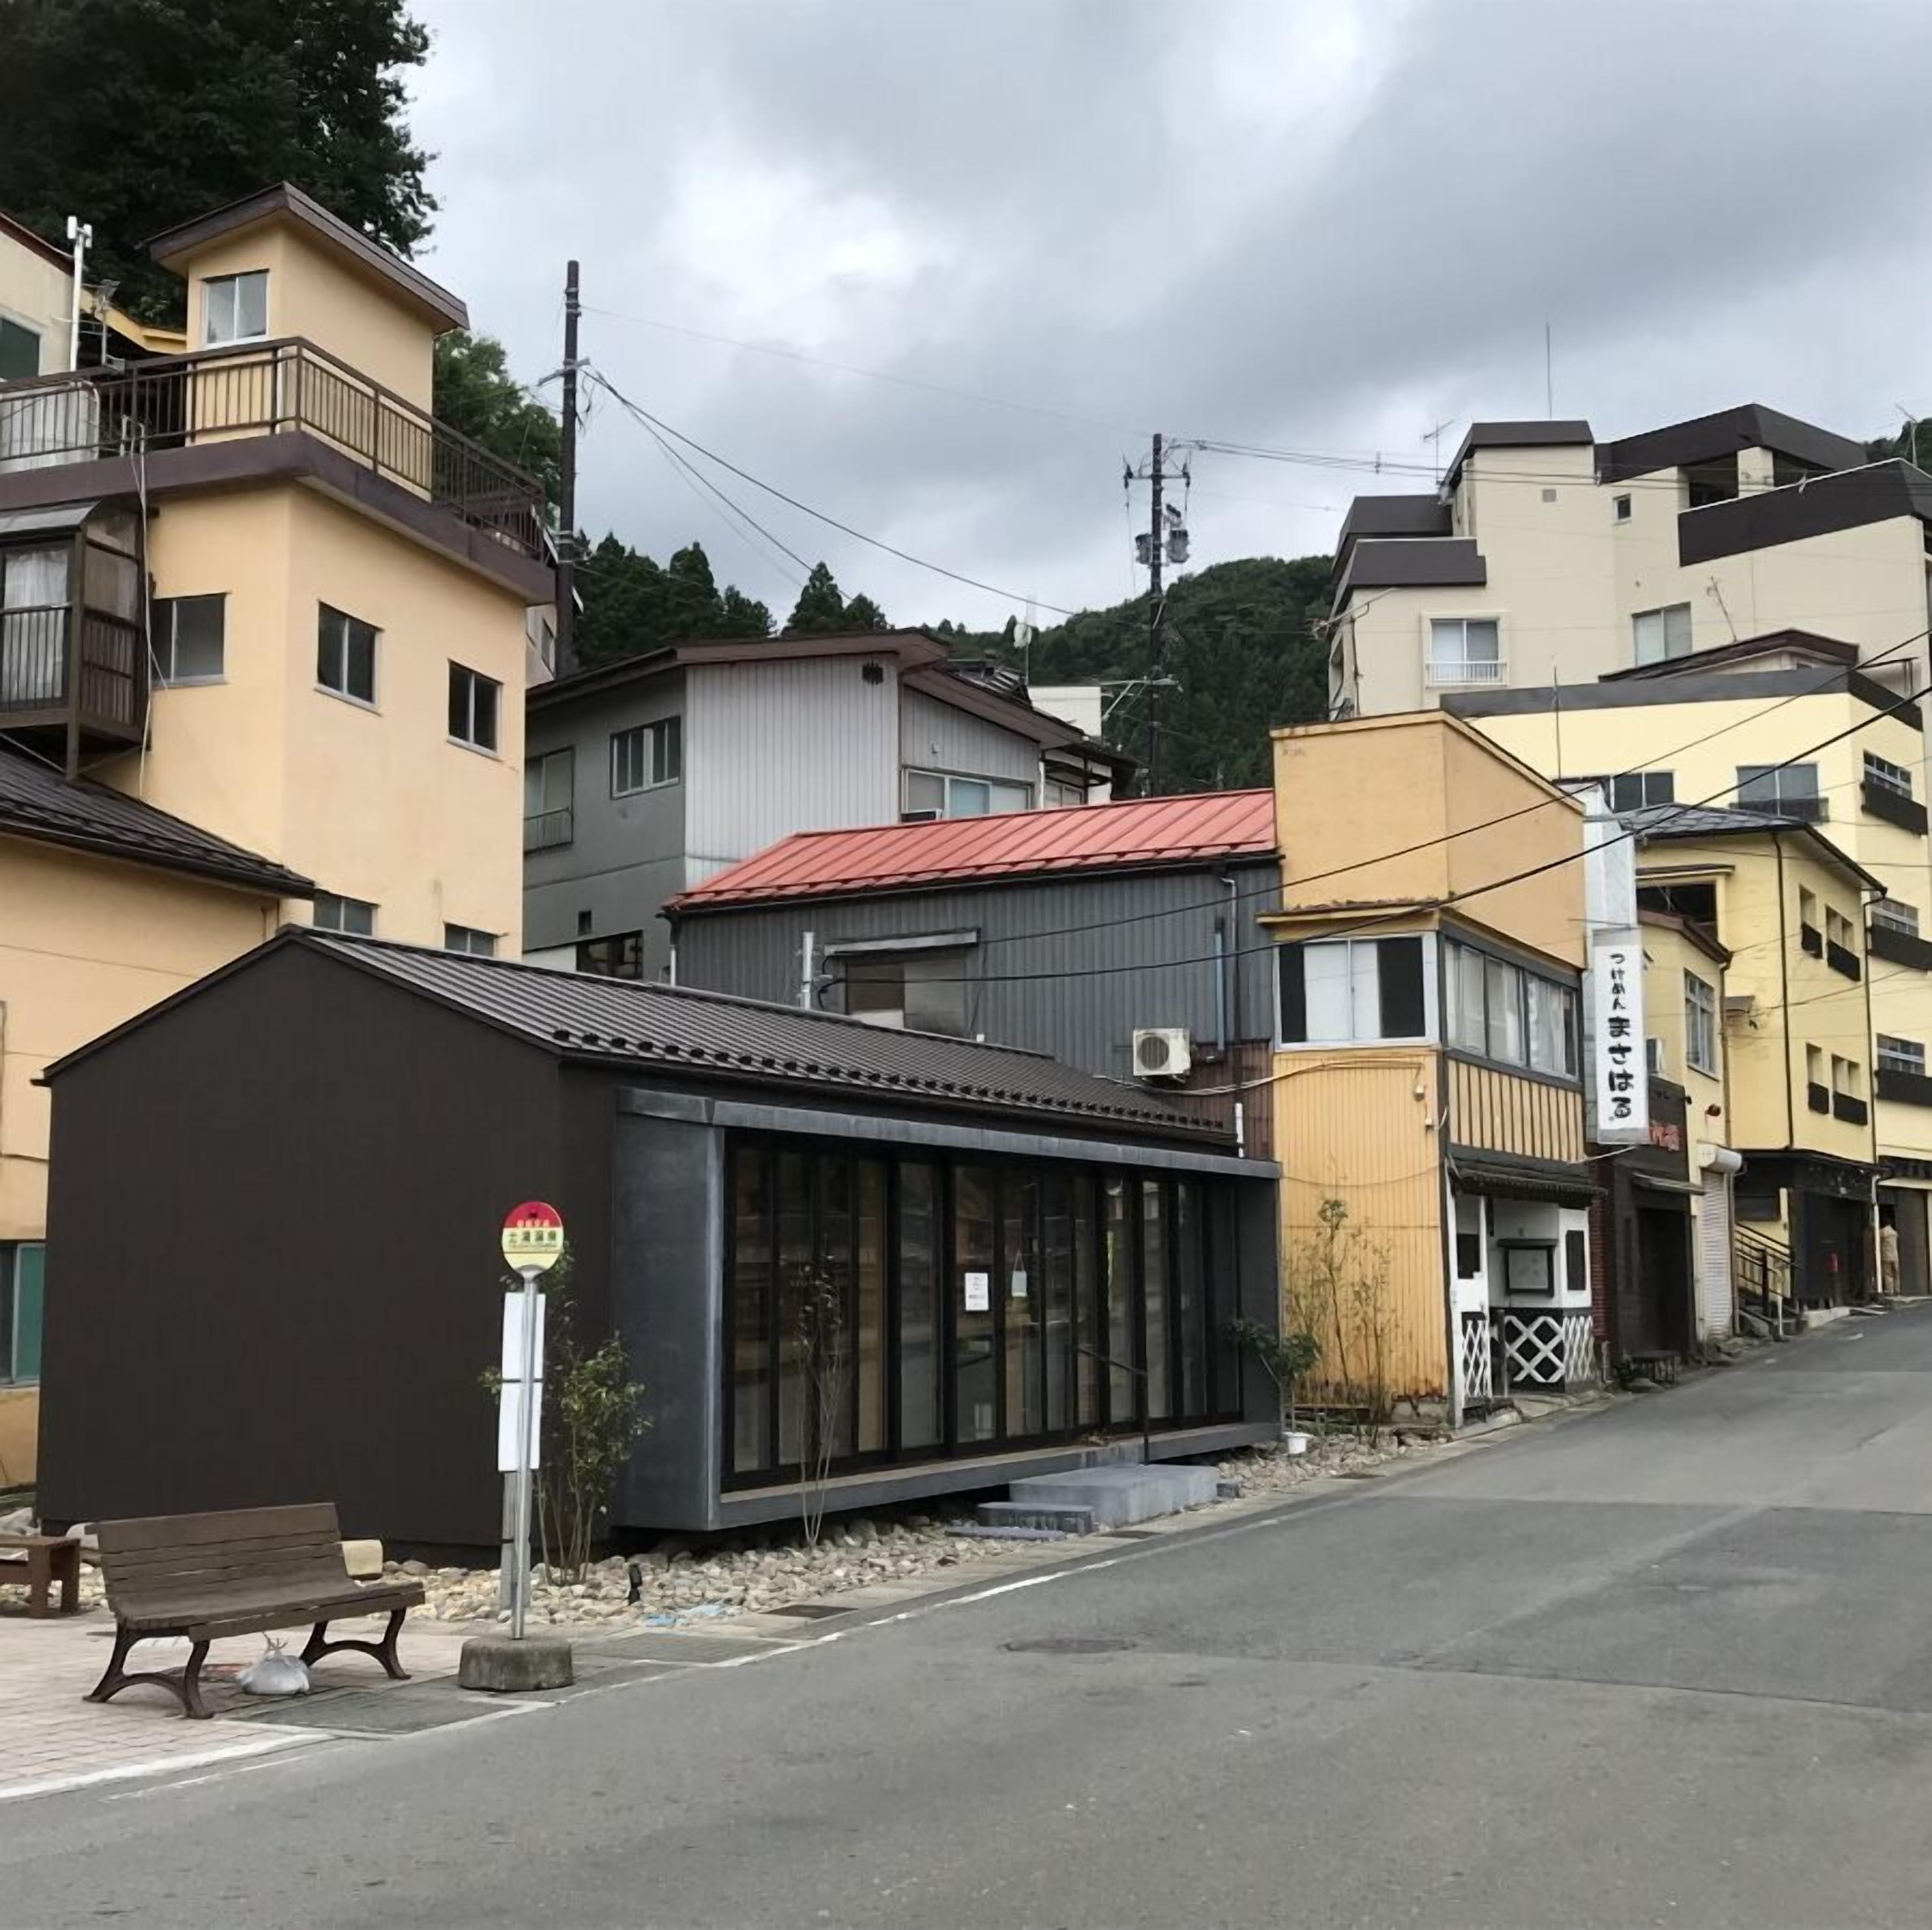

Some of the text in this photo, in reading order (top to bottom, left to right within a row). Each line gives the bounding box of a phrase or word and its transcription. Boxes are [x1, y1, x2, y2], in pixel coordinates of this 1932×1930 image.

[1608, 953, 1634, 1118] つけめん まさはる
